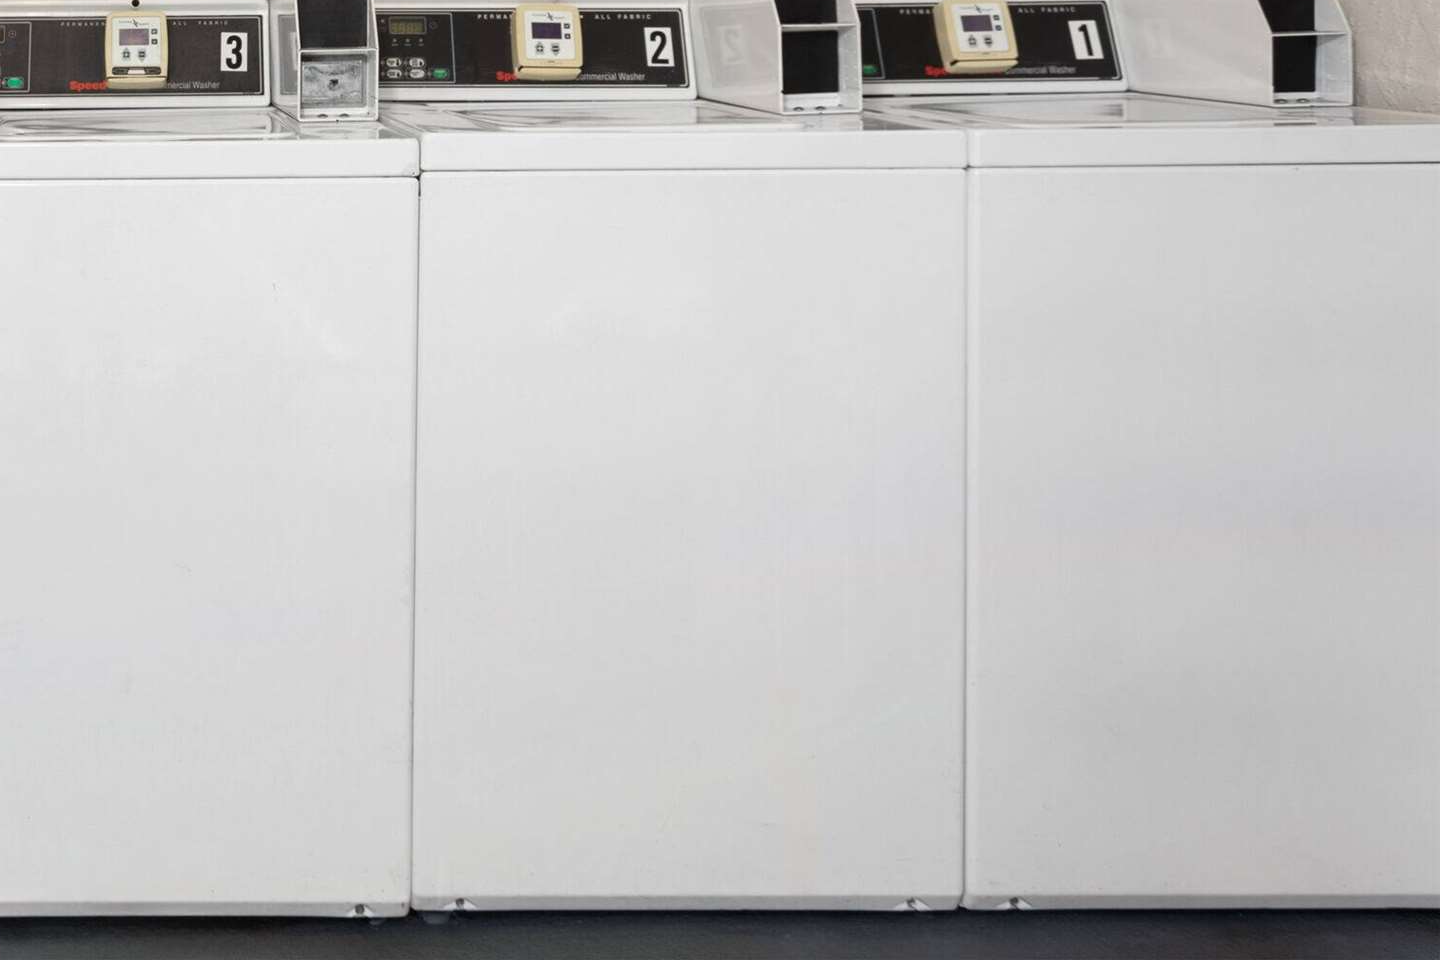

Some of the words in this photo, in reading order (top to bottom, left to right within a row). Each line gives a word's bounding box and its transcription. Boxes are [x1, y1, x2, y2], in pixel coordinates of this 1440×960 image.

[1017, 6, 1035, 14] ALL
[1040, 5, 1076, 13] FABRIC
[649, 30, 670, 65] 2
[1077, 23, 1094, 57] 1
[225, 35, 243, 70] 3
[192, 81, 220, 89] Washer
[578, 72, 617, 81] ommercial
[617, 72, 646, 81] Washer
